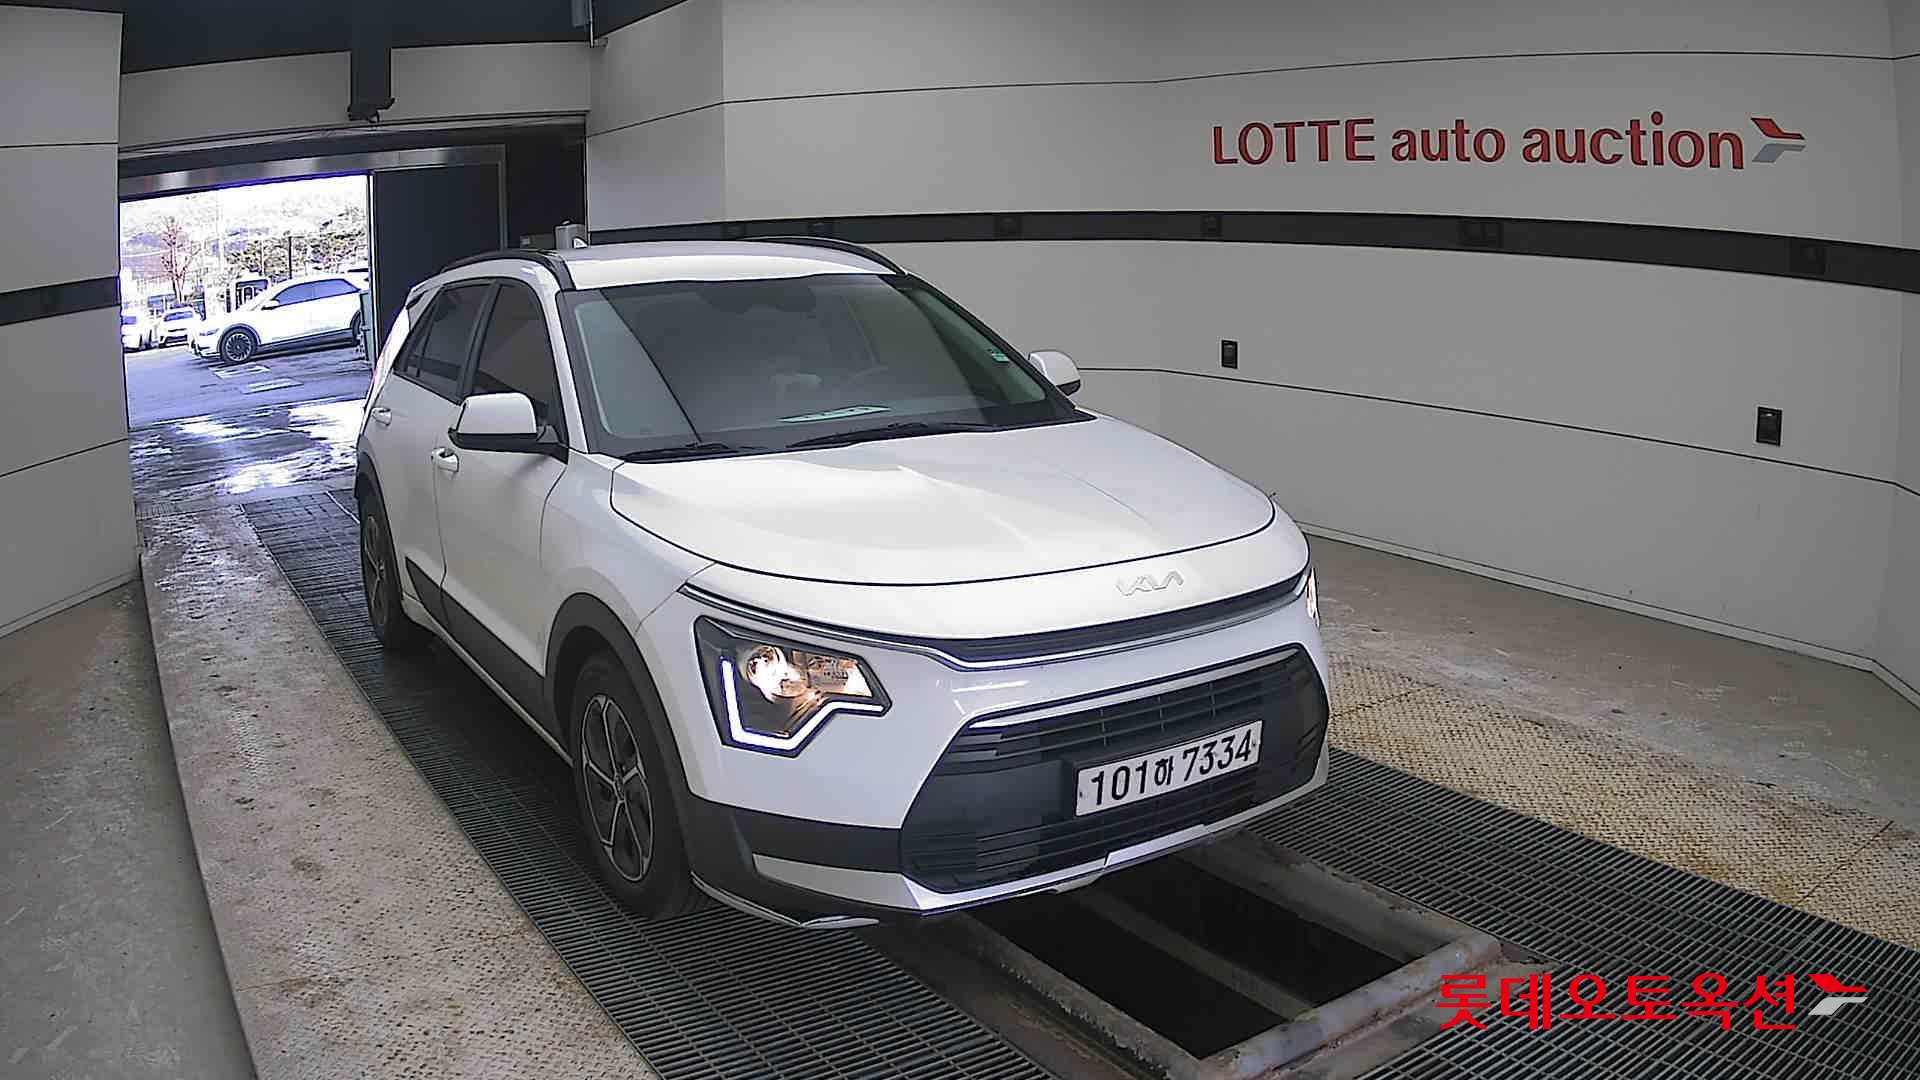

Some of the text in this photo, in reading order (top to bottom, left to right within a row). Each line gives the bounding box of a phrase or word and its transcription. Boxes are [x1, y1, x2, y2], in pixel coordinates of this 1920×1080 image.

[1213, 111, 1744, 169] LOTTE auto auction
[1091, 729, 1252, 806] 101하 7334
